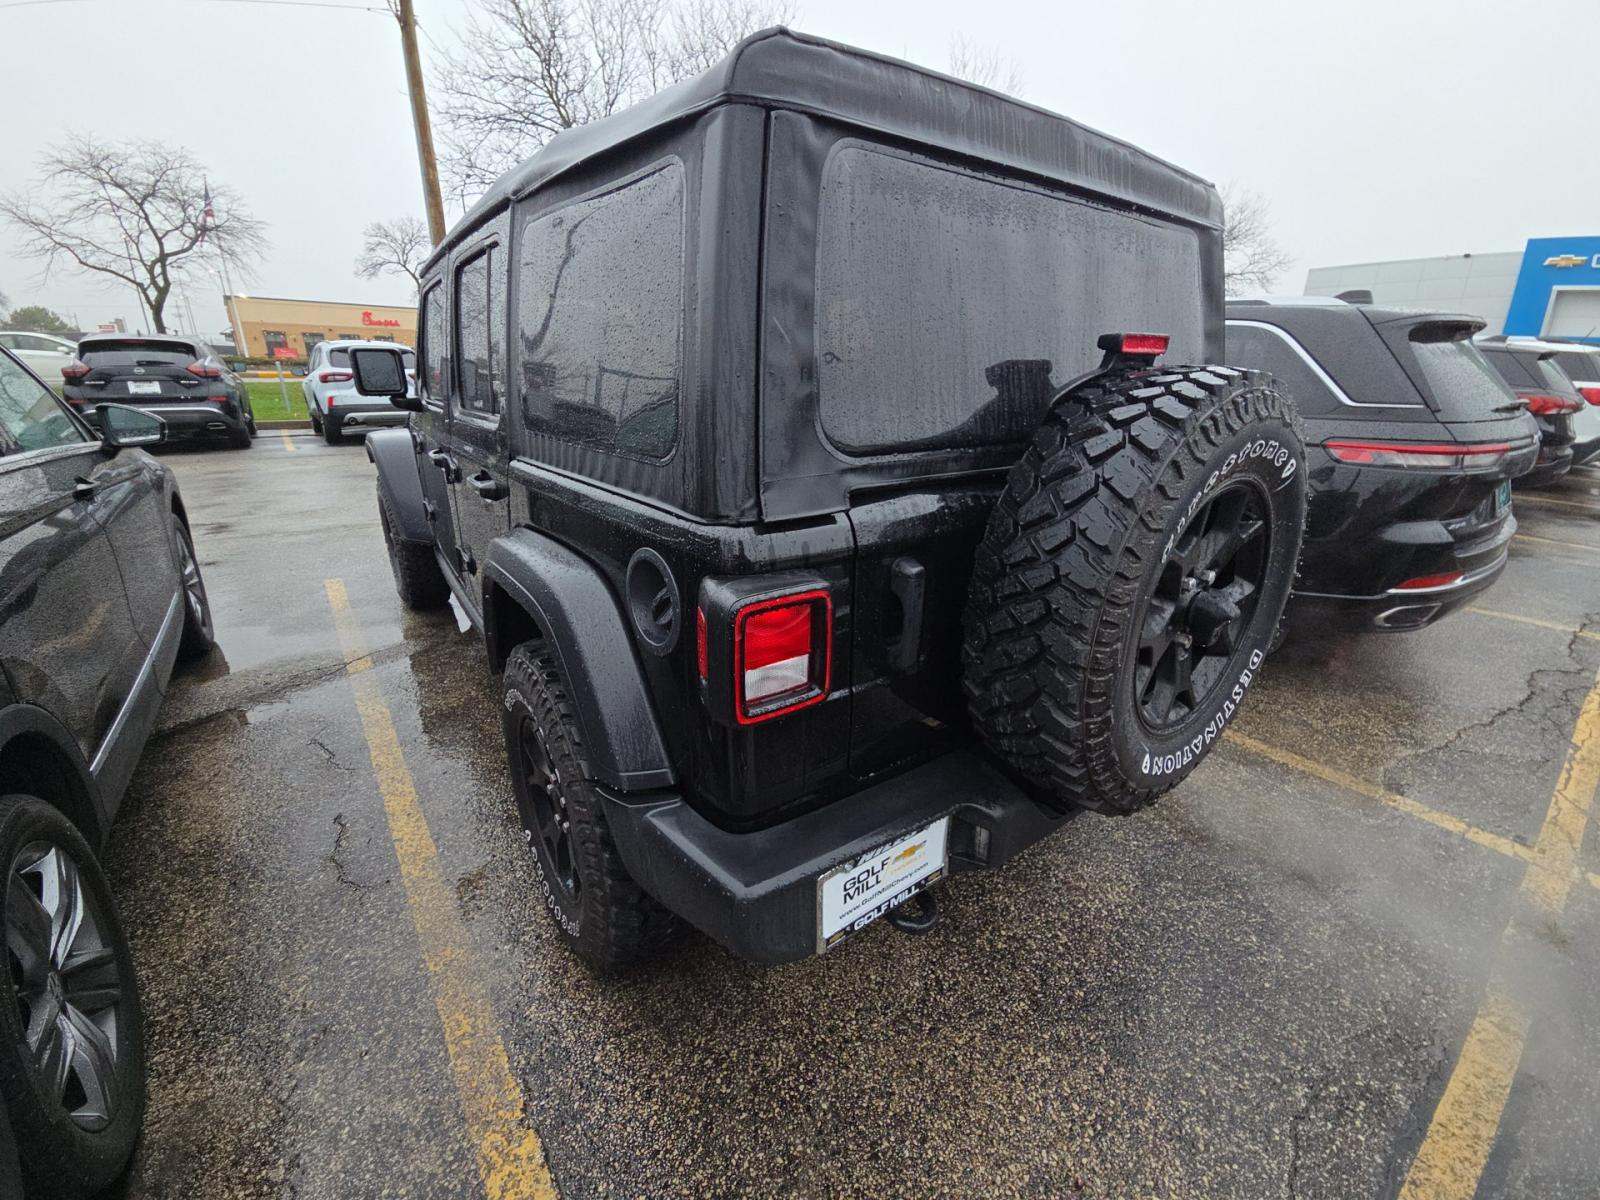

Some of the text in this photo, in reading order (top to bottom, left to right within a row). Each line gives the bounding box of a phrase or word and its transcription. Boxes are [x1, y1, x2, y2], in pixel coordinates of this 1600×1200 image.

[1152, 648, 1264, 776] DESTINATION
[843, 856, 891, 893] GOLF
[843, 874, 882, 905] MILL
